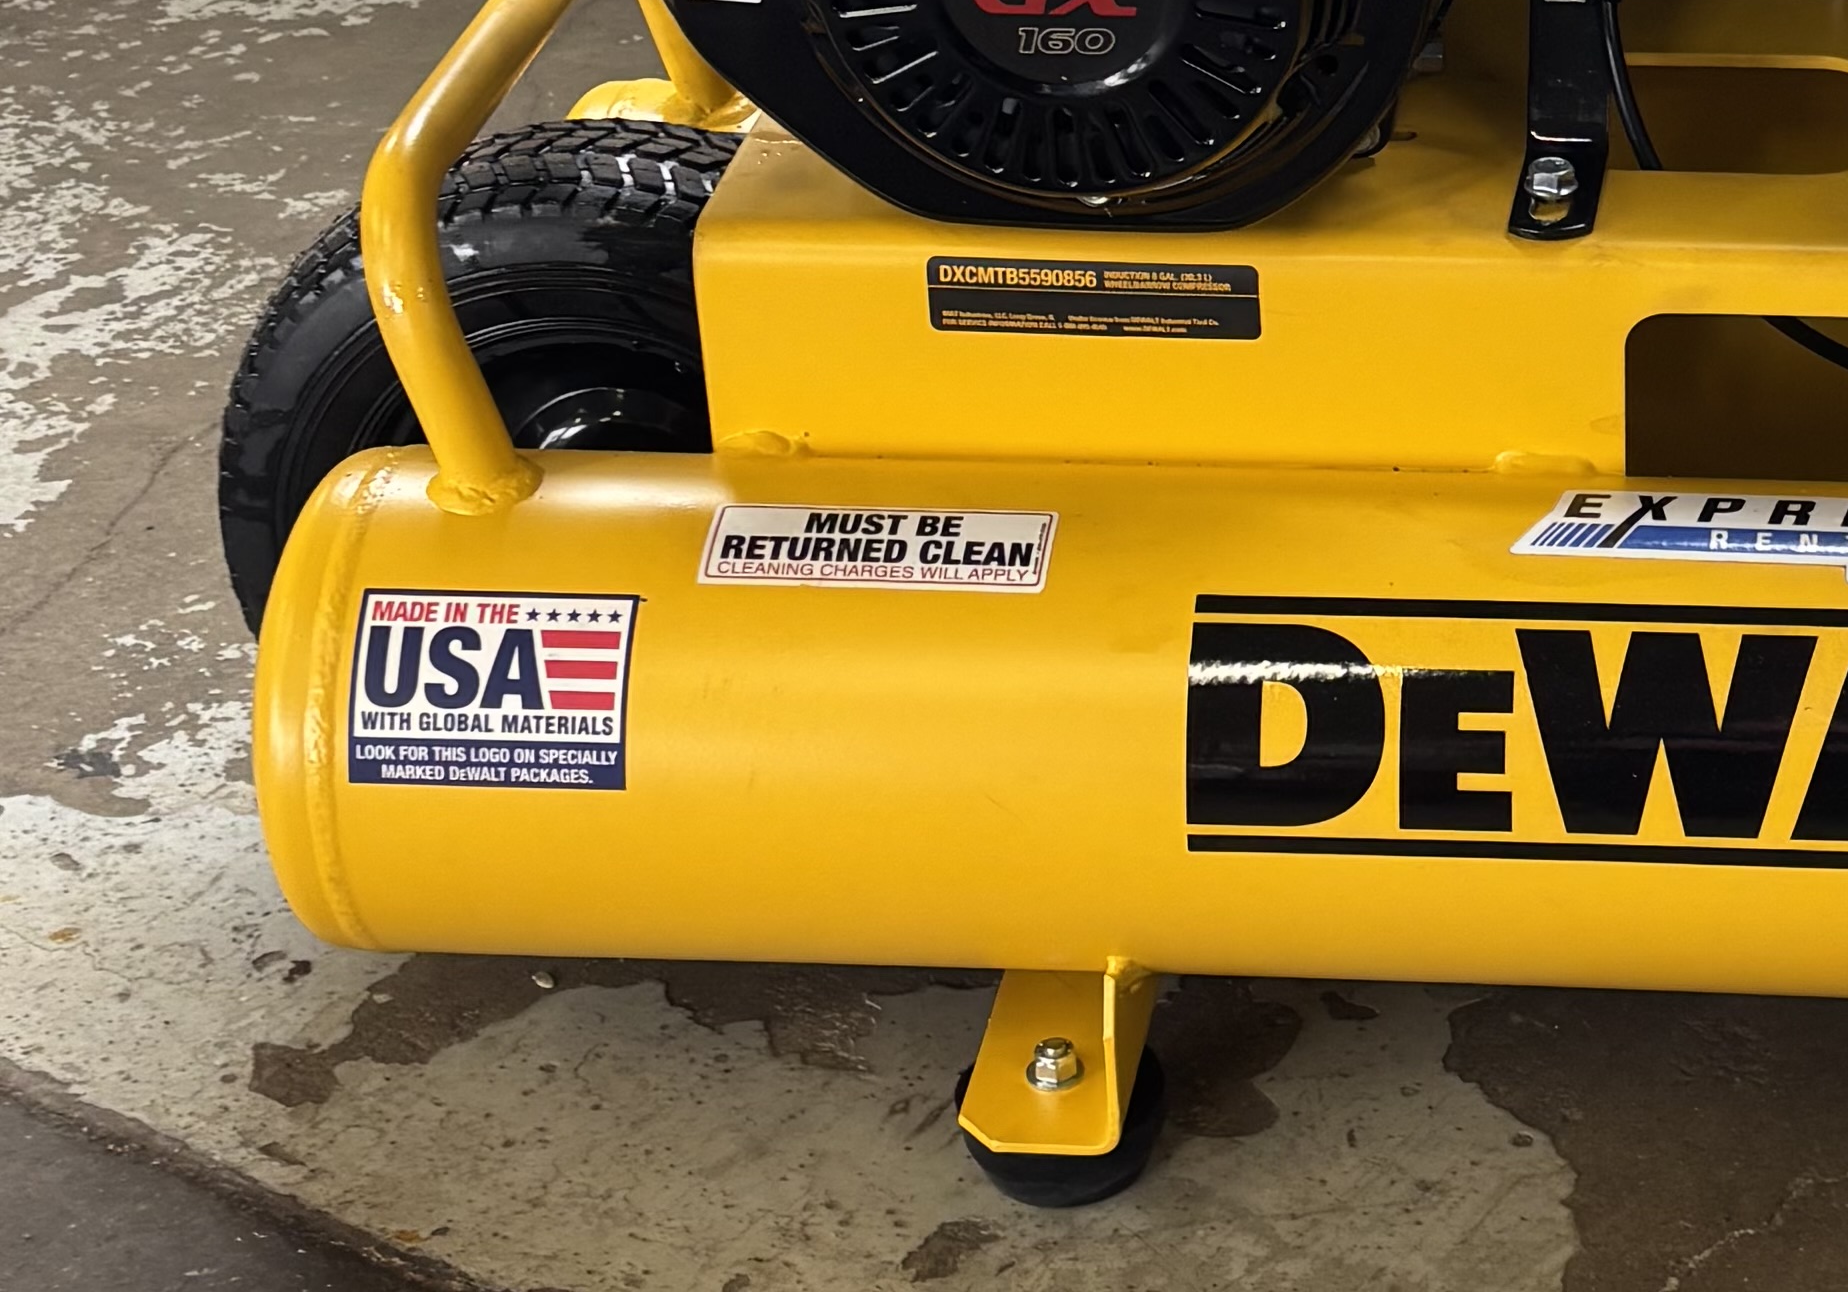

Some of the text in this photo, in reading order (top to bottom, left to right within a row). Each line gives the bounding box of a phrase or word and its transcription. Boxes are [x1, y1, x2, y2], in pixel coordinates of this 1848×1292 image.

[1018, 27, 1116, 54] 160
[938, 264, 1098, 288] DXCMTB5590856
[804, 512, 964, 537] MUST BE
[719, 535, 908, 564] RETURNED
[918, 540, 1035, 568] CLEAN
[717, 561, 1030, 583] CLEANING CHARGES WILL APPLY
[371, 600, 521, 624] MADE IN THE
[364, 625, 545, 709] USA
[361, 711, 614, 736] WITH GLOBAL MATERIALS
[355, 744, 618, 766] LOOK FOR THIS LOGO ON SPECIALLY
[381, 764, 444, 781] MARKED
[510, 767, 594, 784] PACKAGES.
